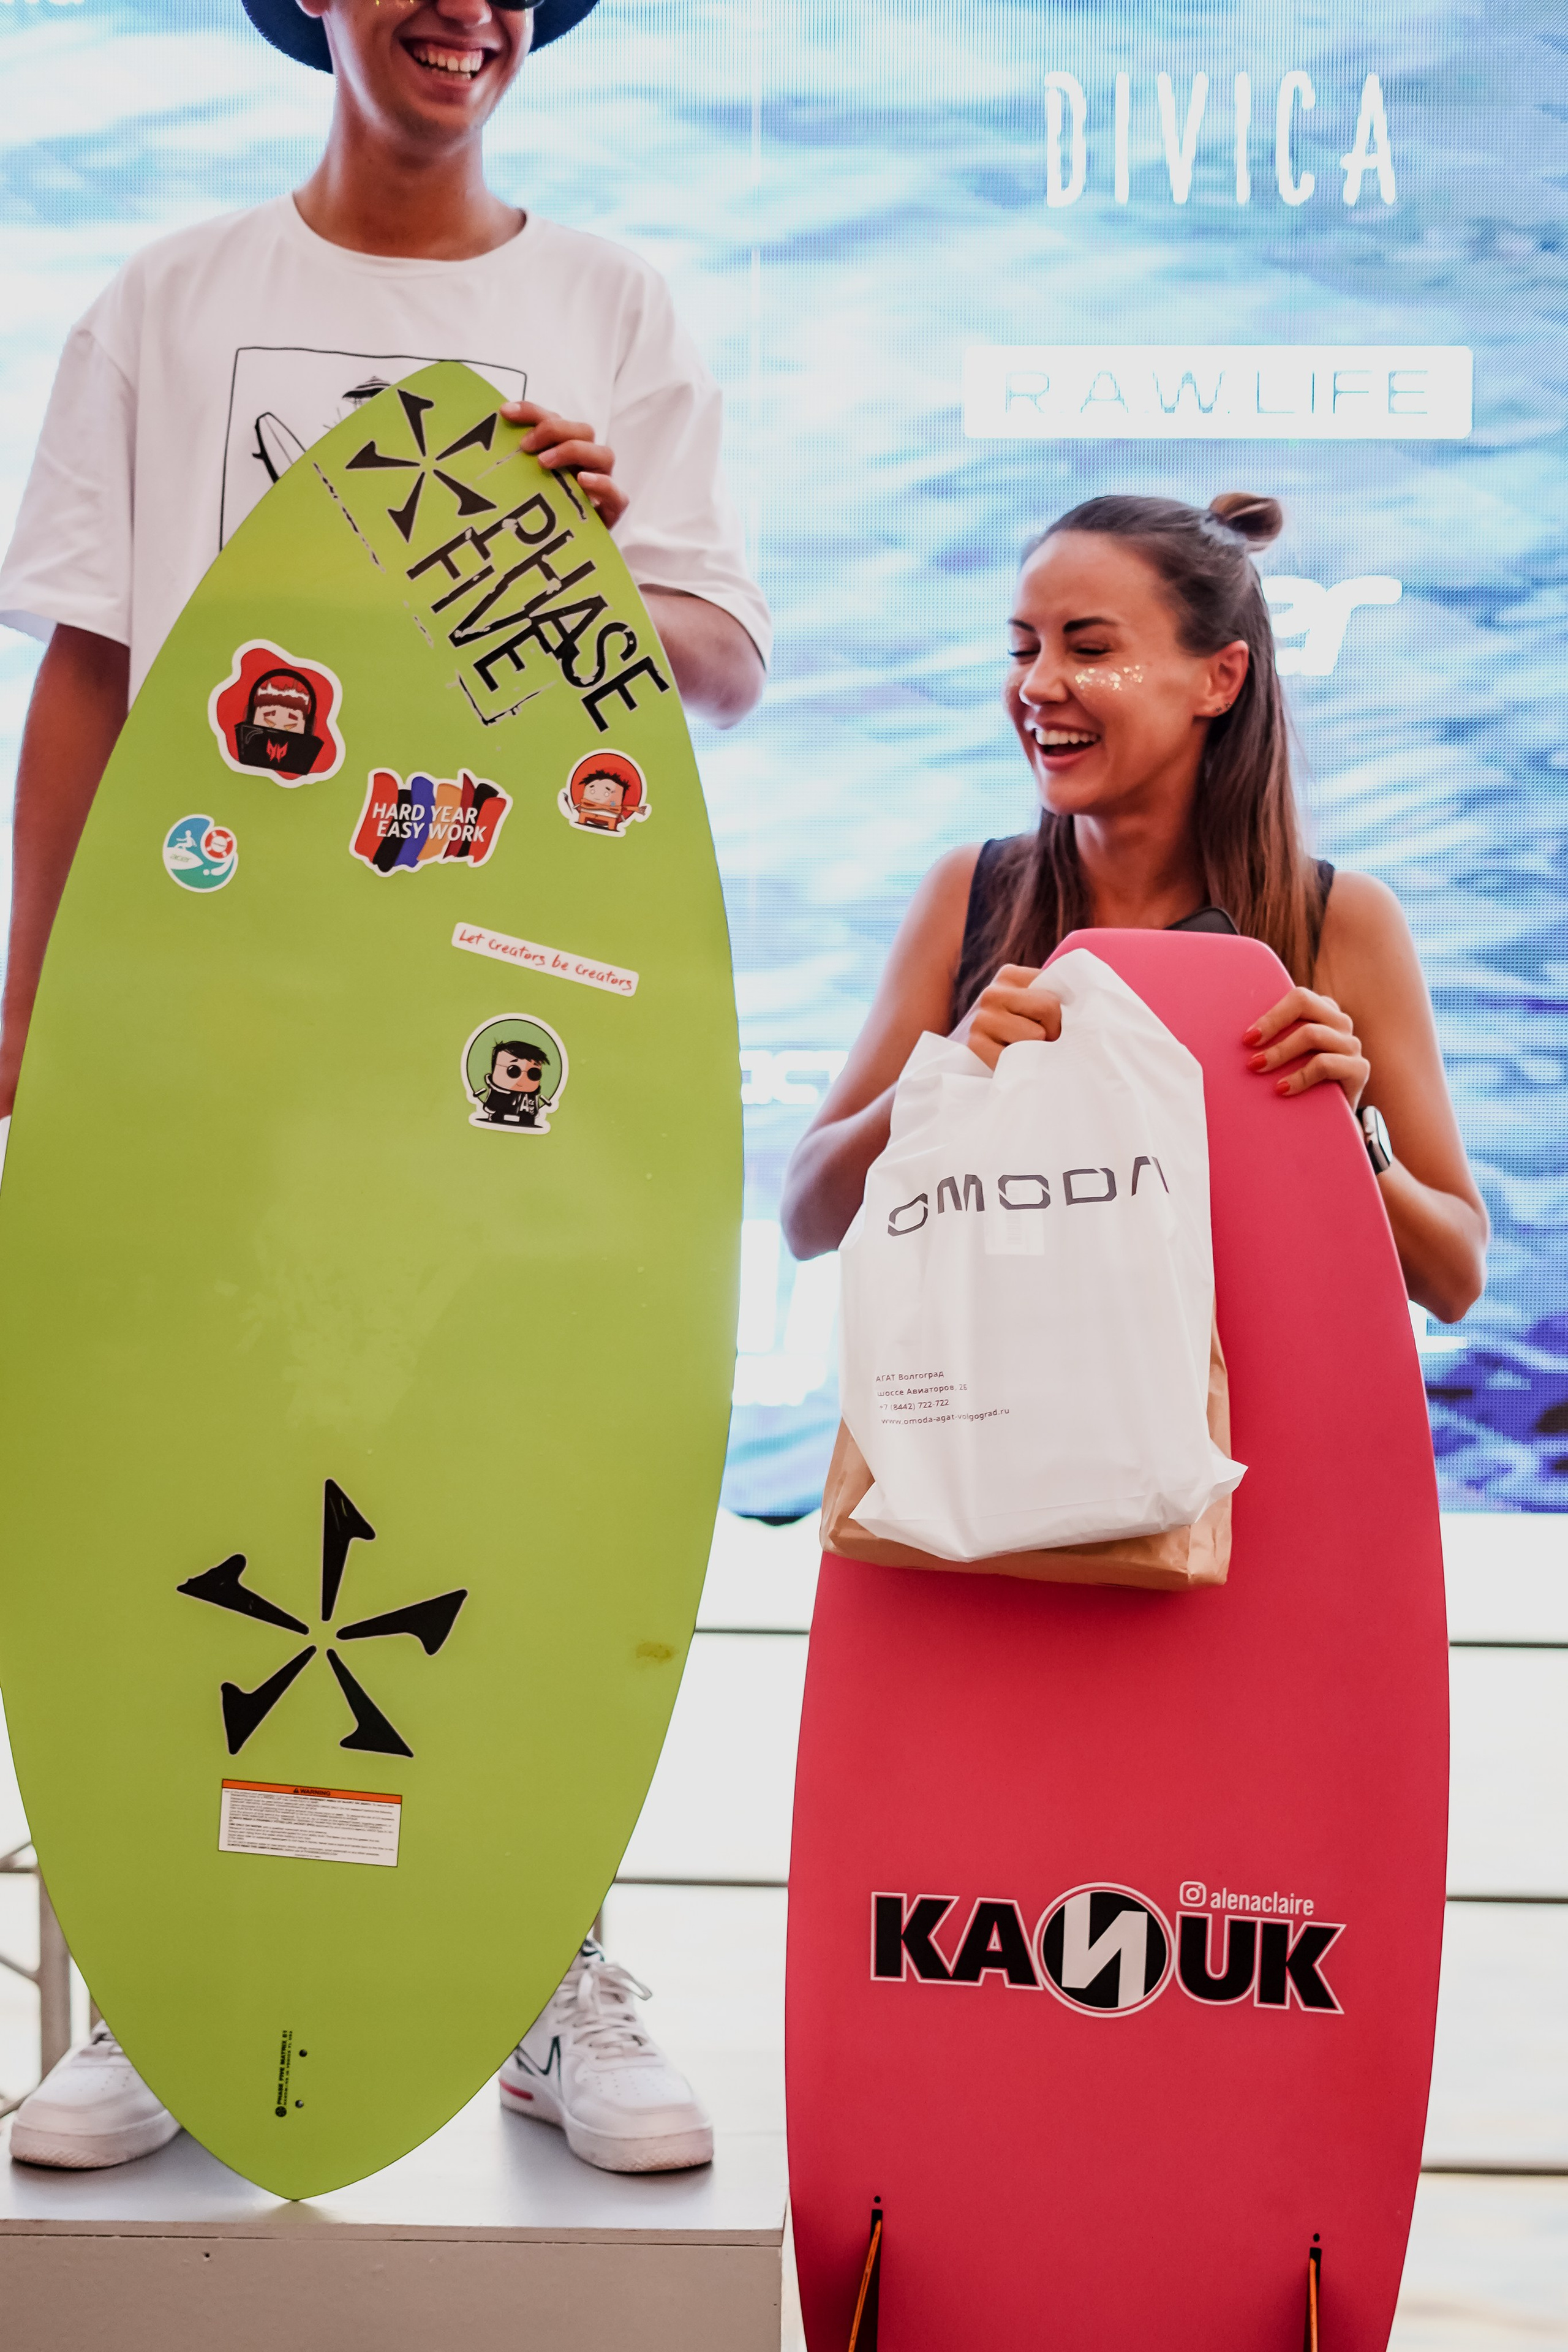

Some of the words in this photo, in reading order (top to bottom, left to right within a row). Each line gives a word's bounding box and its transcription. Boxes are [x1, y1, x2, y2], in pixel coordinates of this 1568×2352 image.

[1044, 70, 1396, 206] DIVICA
[406, 526, 553, 693] FIVE
[477, 492, 670, 733] PHASE
[372, 802, 426, 821] HARD
[431, 805, 478, 824] YEAR
[376, 820, 425, 839] EASY
[428, 824, 488, 843] WORK
[459, 929, 485, 945] Let
[551, 954, 568, 971] be
[898, 1371, 944, 1381] Волгоград
[918, 1399, 950, 1409] 722-722
[1210, 1887, 1314, 1917] alenaclaire
